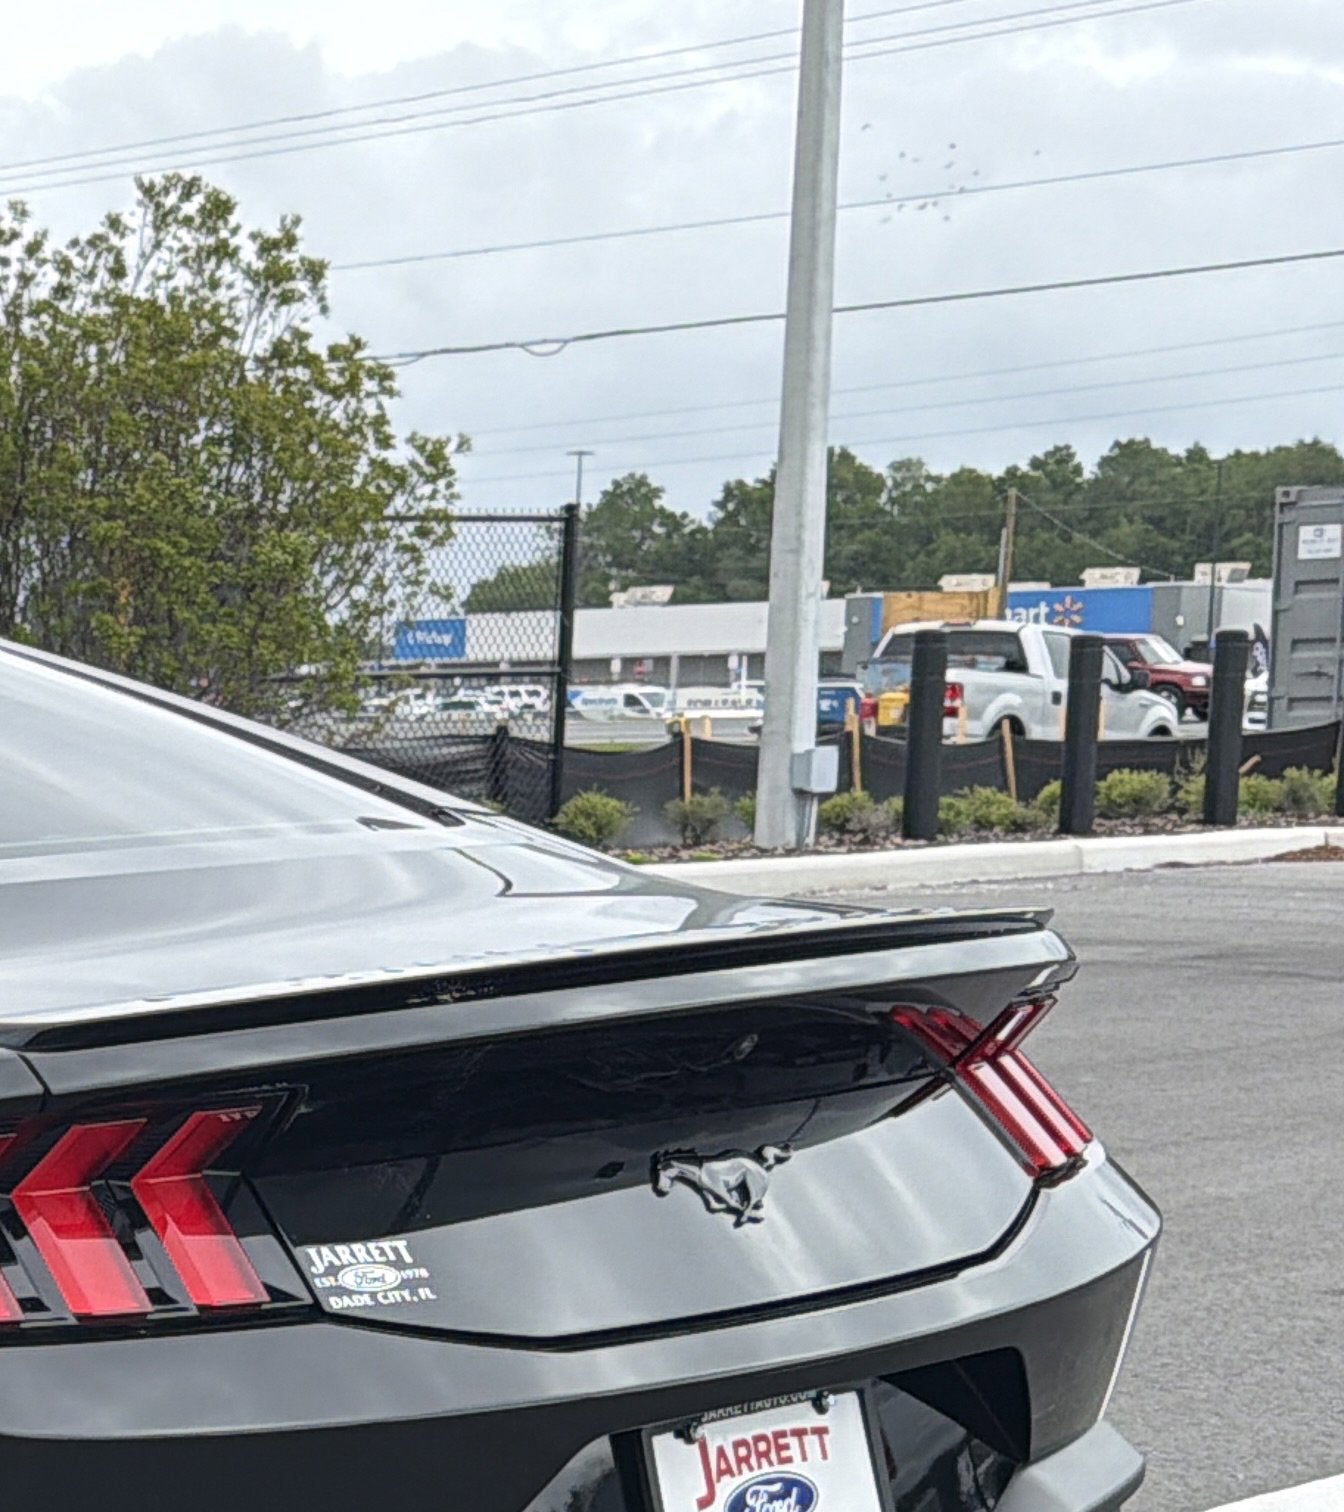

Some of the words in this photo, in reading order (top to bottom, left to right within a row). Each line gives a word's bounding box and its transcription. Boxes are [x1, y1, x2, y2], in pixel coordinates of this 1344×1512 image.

[305, 1240, 414, 1274] JARRETT
[328, 1294, 375, 1310] DADE
[695, 1426, 830, 1512] JARRETT
